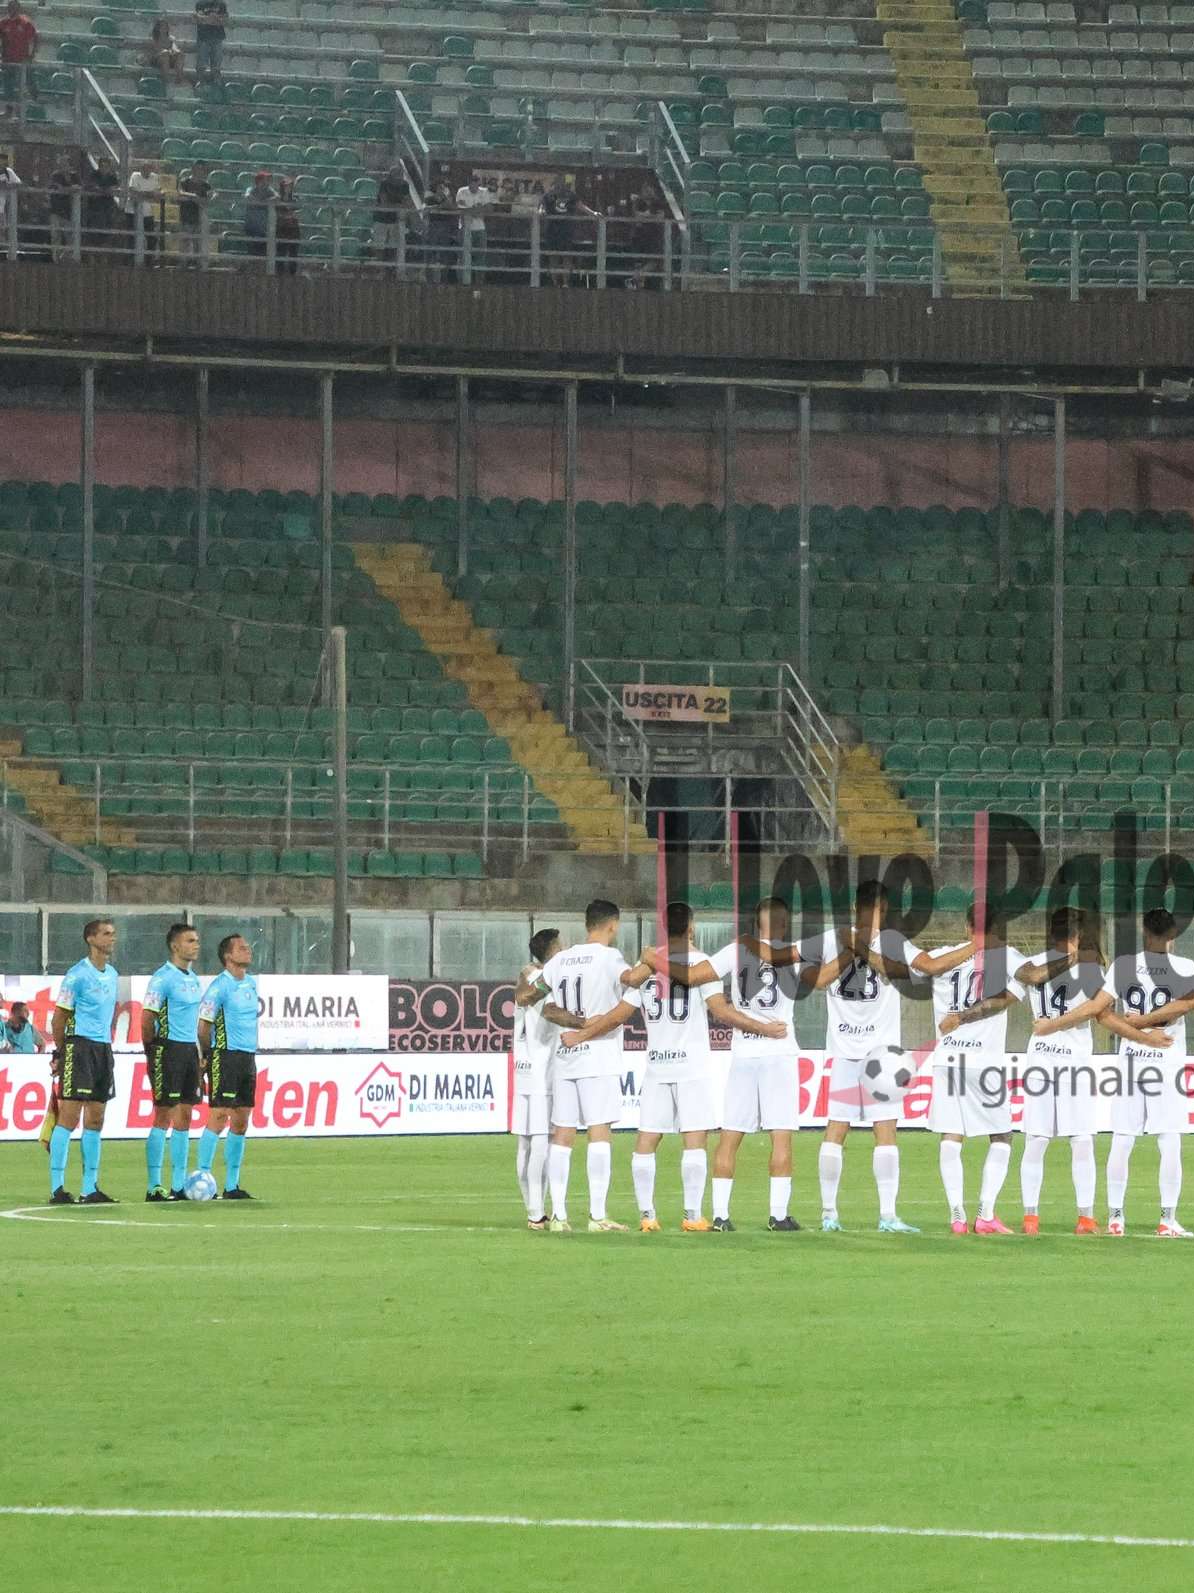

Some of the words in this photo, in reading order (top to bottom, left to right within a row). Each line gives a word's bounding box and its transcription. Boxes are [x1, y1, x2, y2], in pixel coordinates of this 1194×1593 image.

[625, 692, 699, 709] USCITA
[704, 697, 727, 713] 22
[558, 974, 586, 1017] 11
[737, 966, 779, 1010] 13
[832, 957, 881, 1002] 23
[283, 996, 359, 1018] MARIA
[643, 977, 690, 1023] 30
[1034, 980, 1069, 1020] 14
[389, 1032, 513, 1051] ECOSERVICE
[367, 1084, 395, 1102] GDM
[410, 1074, 427, 1100] DI
[434, 1073, 494, 1099] MARIA
